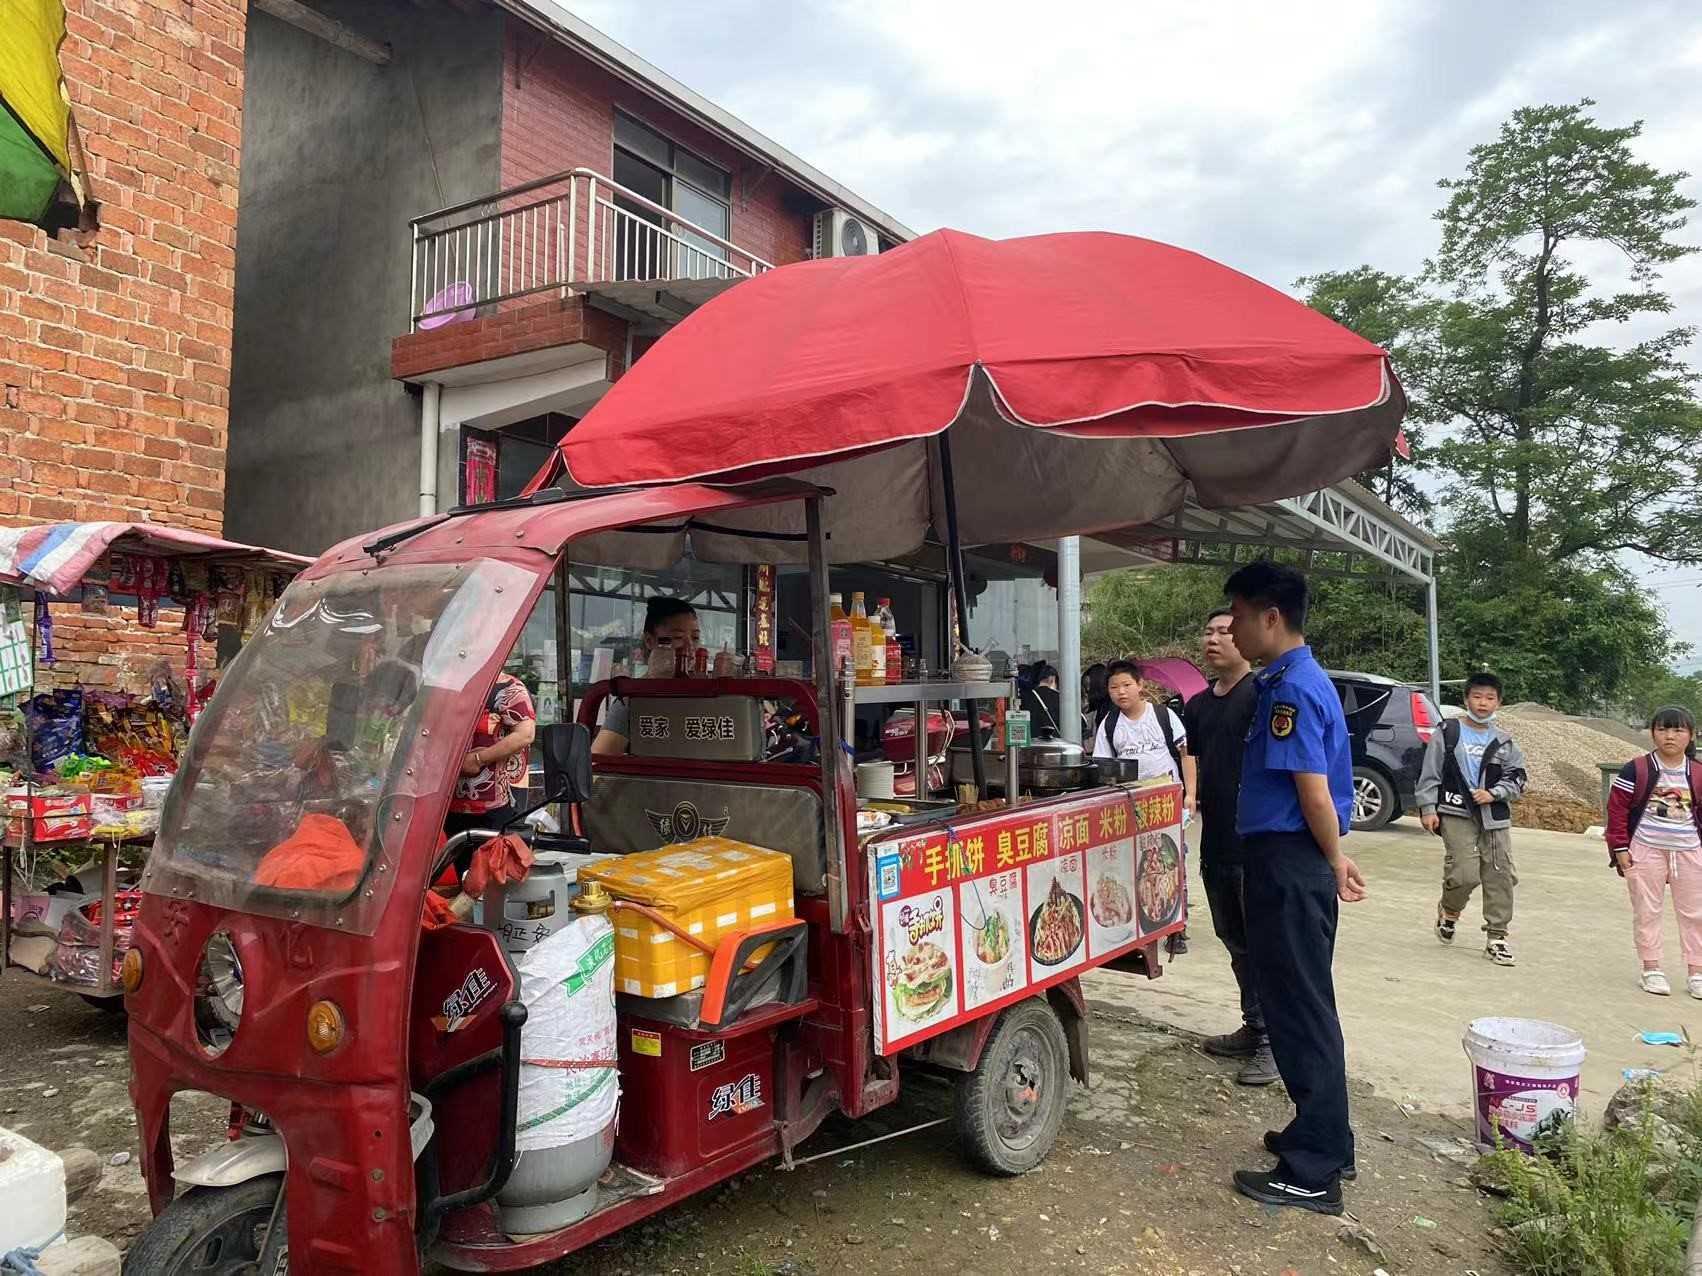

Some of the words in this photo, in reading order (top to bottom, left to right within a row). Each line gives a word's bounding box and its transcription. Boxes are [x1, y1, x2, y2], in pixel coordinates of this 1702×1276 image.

[639, 715, 669, 738] 爱家
[685, 716, 736, 742] 爱绿佳
[1444, 791, 1464, 806] VS
[924, 833, 985, 886] 手抓饼
[996, 821, 1050, 869] 臭豆腐
[1058, 812, 1091, 850] 凉面
[1099, 803, 1128, 839] 米粉
[1136, 793, 1176, 832] 酸辣粉
[443, 967, 491, 1032] 绿佳
[708, 1073, 761, 1121] 绿佳
